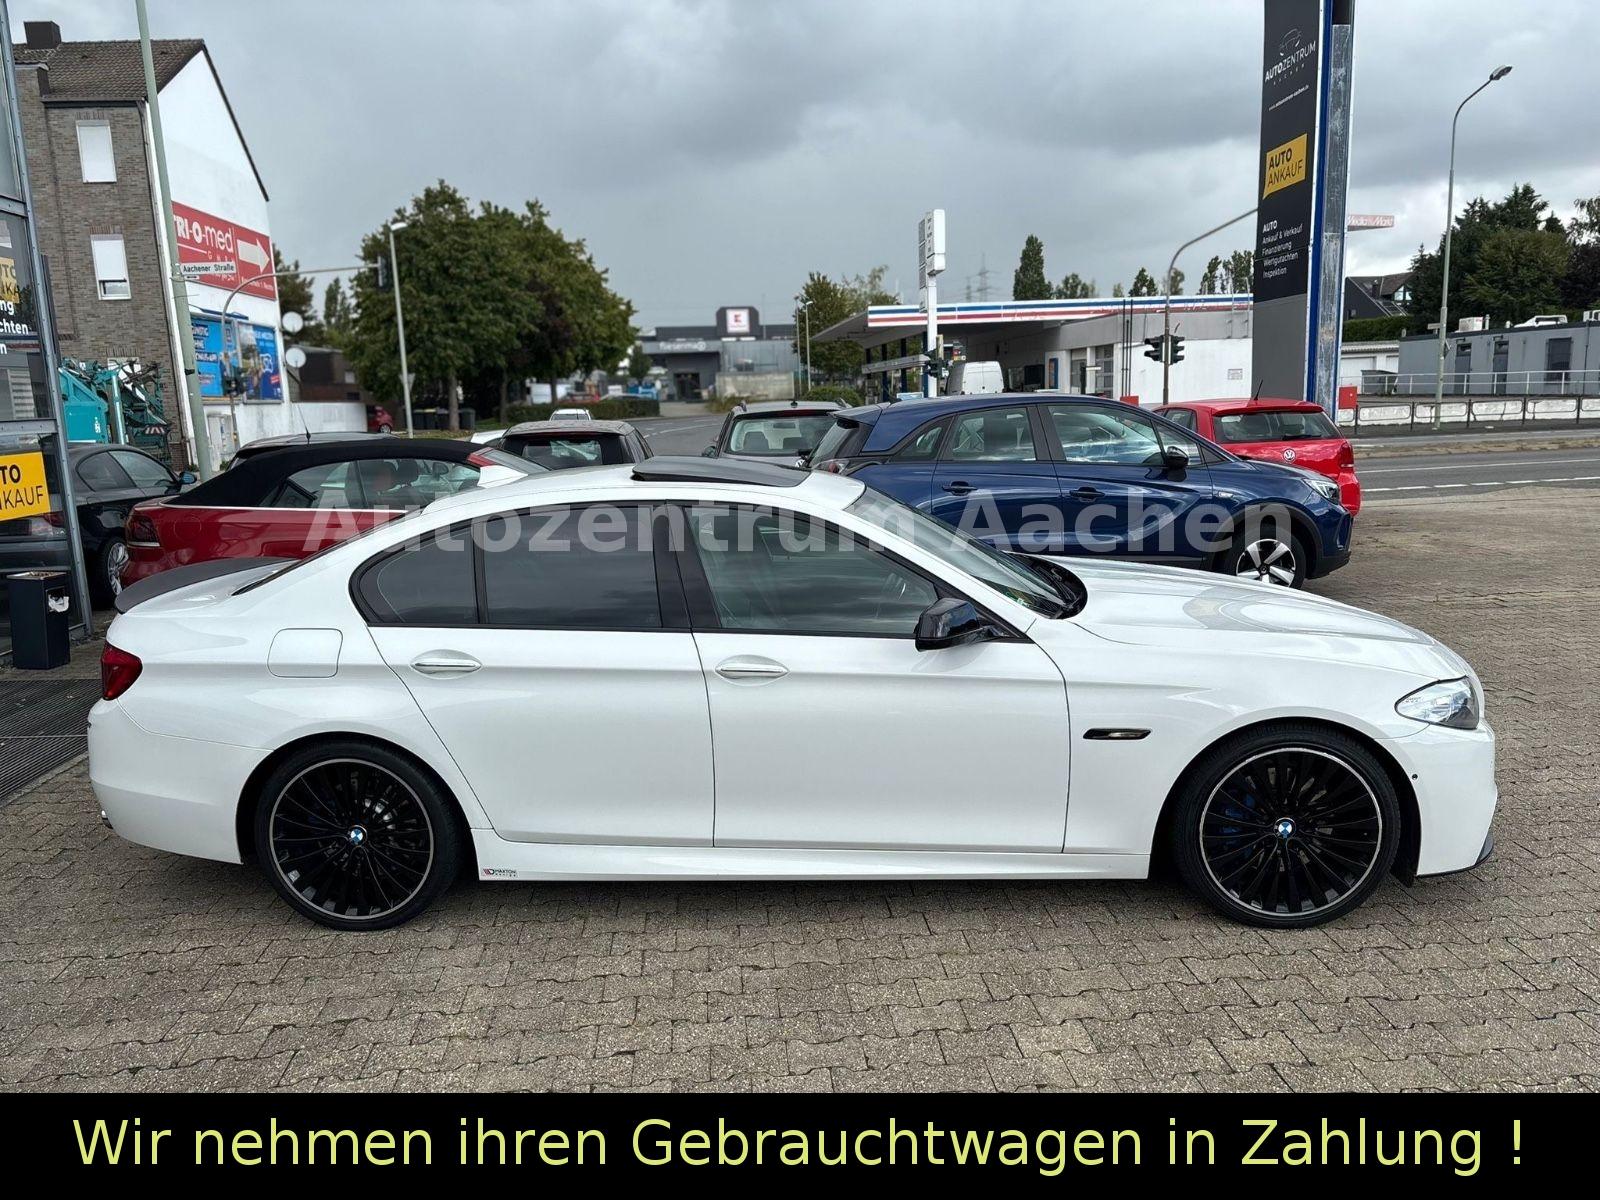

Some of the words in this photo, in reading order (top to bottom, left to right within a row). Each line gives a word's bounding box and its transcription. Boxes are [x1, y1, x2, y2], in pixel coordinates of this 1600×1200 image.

[1265, 41, 1316, 83] AUTOZENTRUM
[1268, 147, 1292, 170] AUTO
[1267, 159, 1303, 187] ANKAUF
[1262, 220, 1278, 233] AUTO
[183, 264, 211, 272] Aachener
